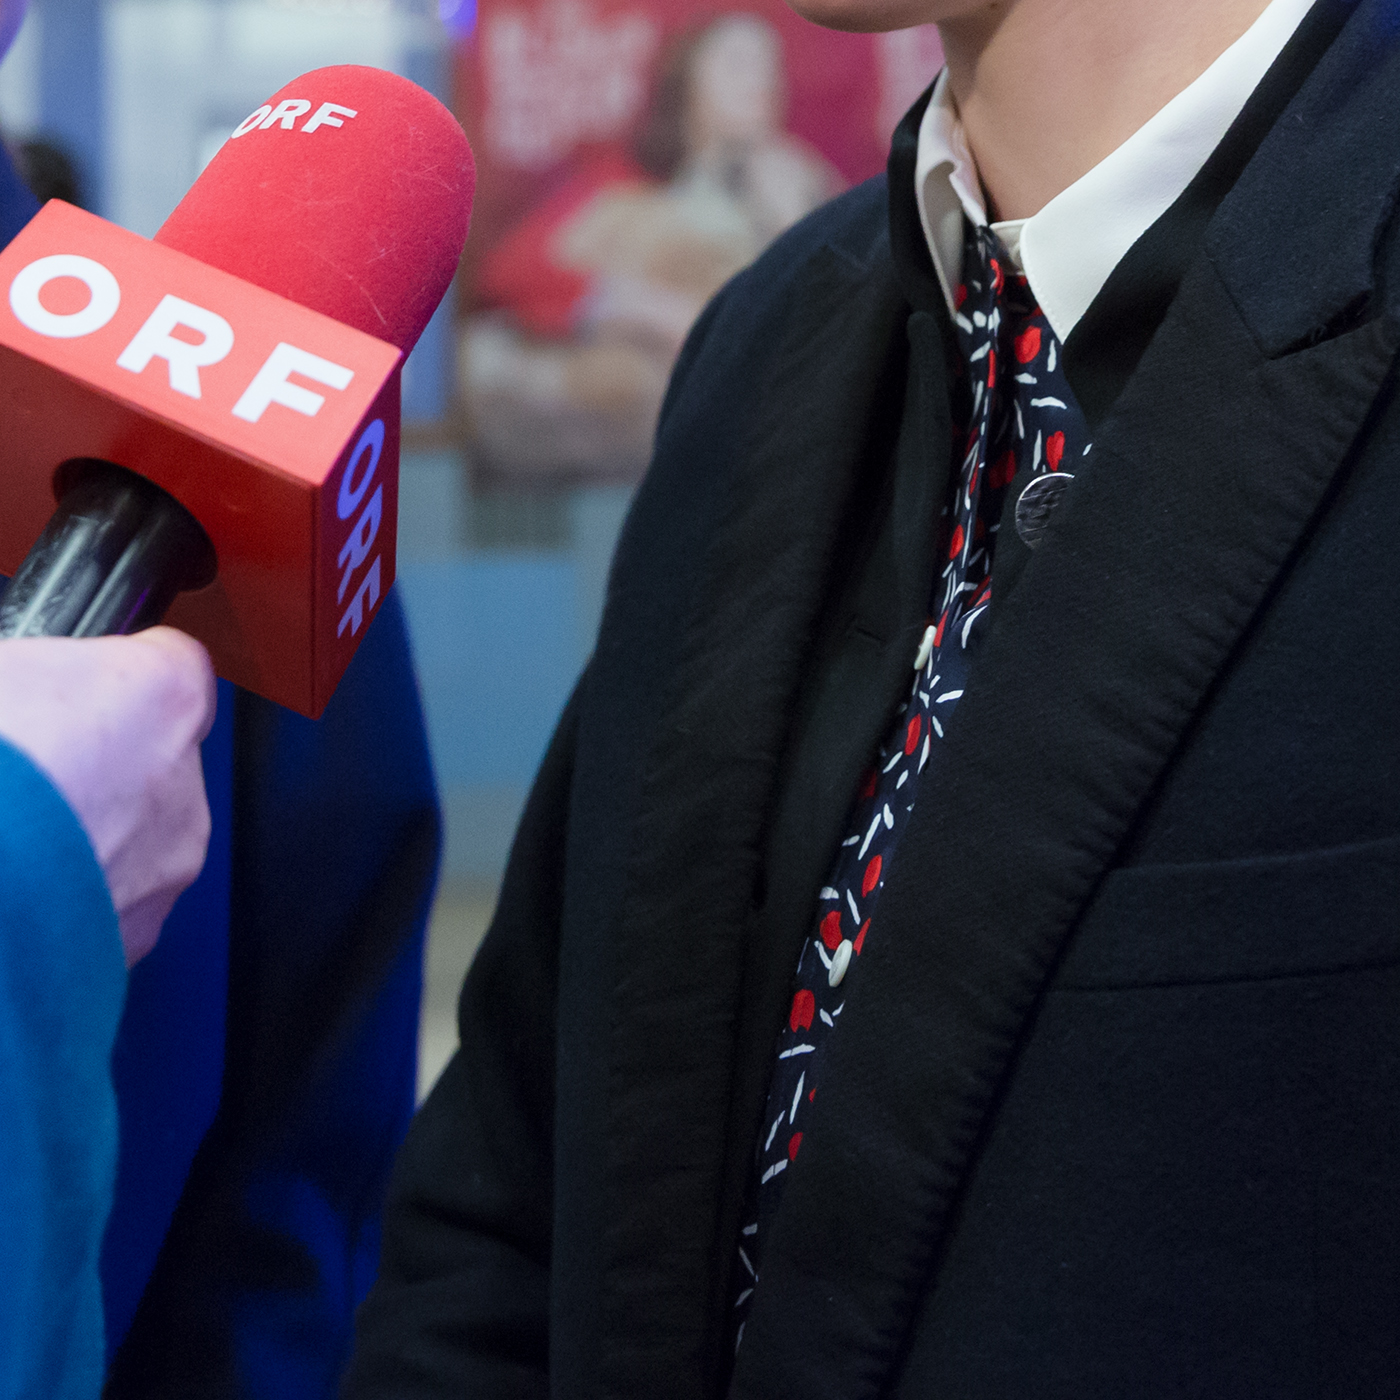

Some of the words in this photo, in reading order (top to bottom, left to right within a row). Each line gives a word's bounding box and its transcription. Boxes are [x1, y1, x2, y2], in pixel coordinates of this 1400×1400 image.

[231, 98, 358, 139] ORF
[9, 254, 355, 424] ORF
[336, 418, 385, 639] ORF
